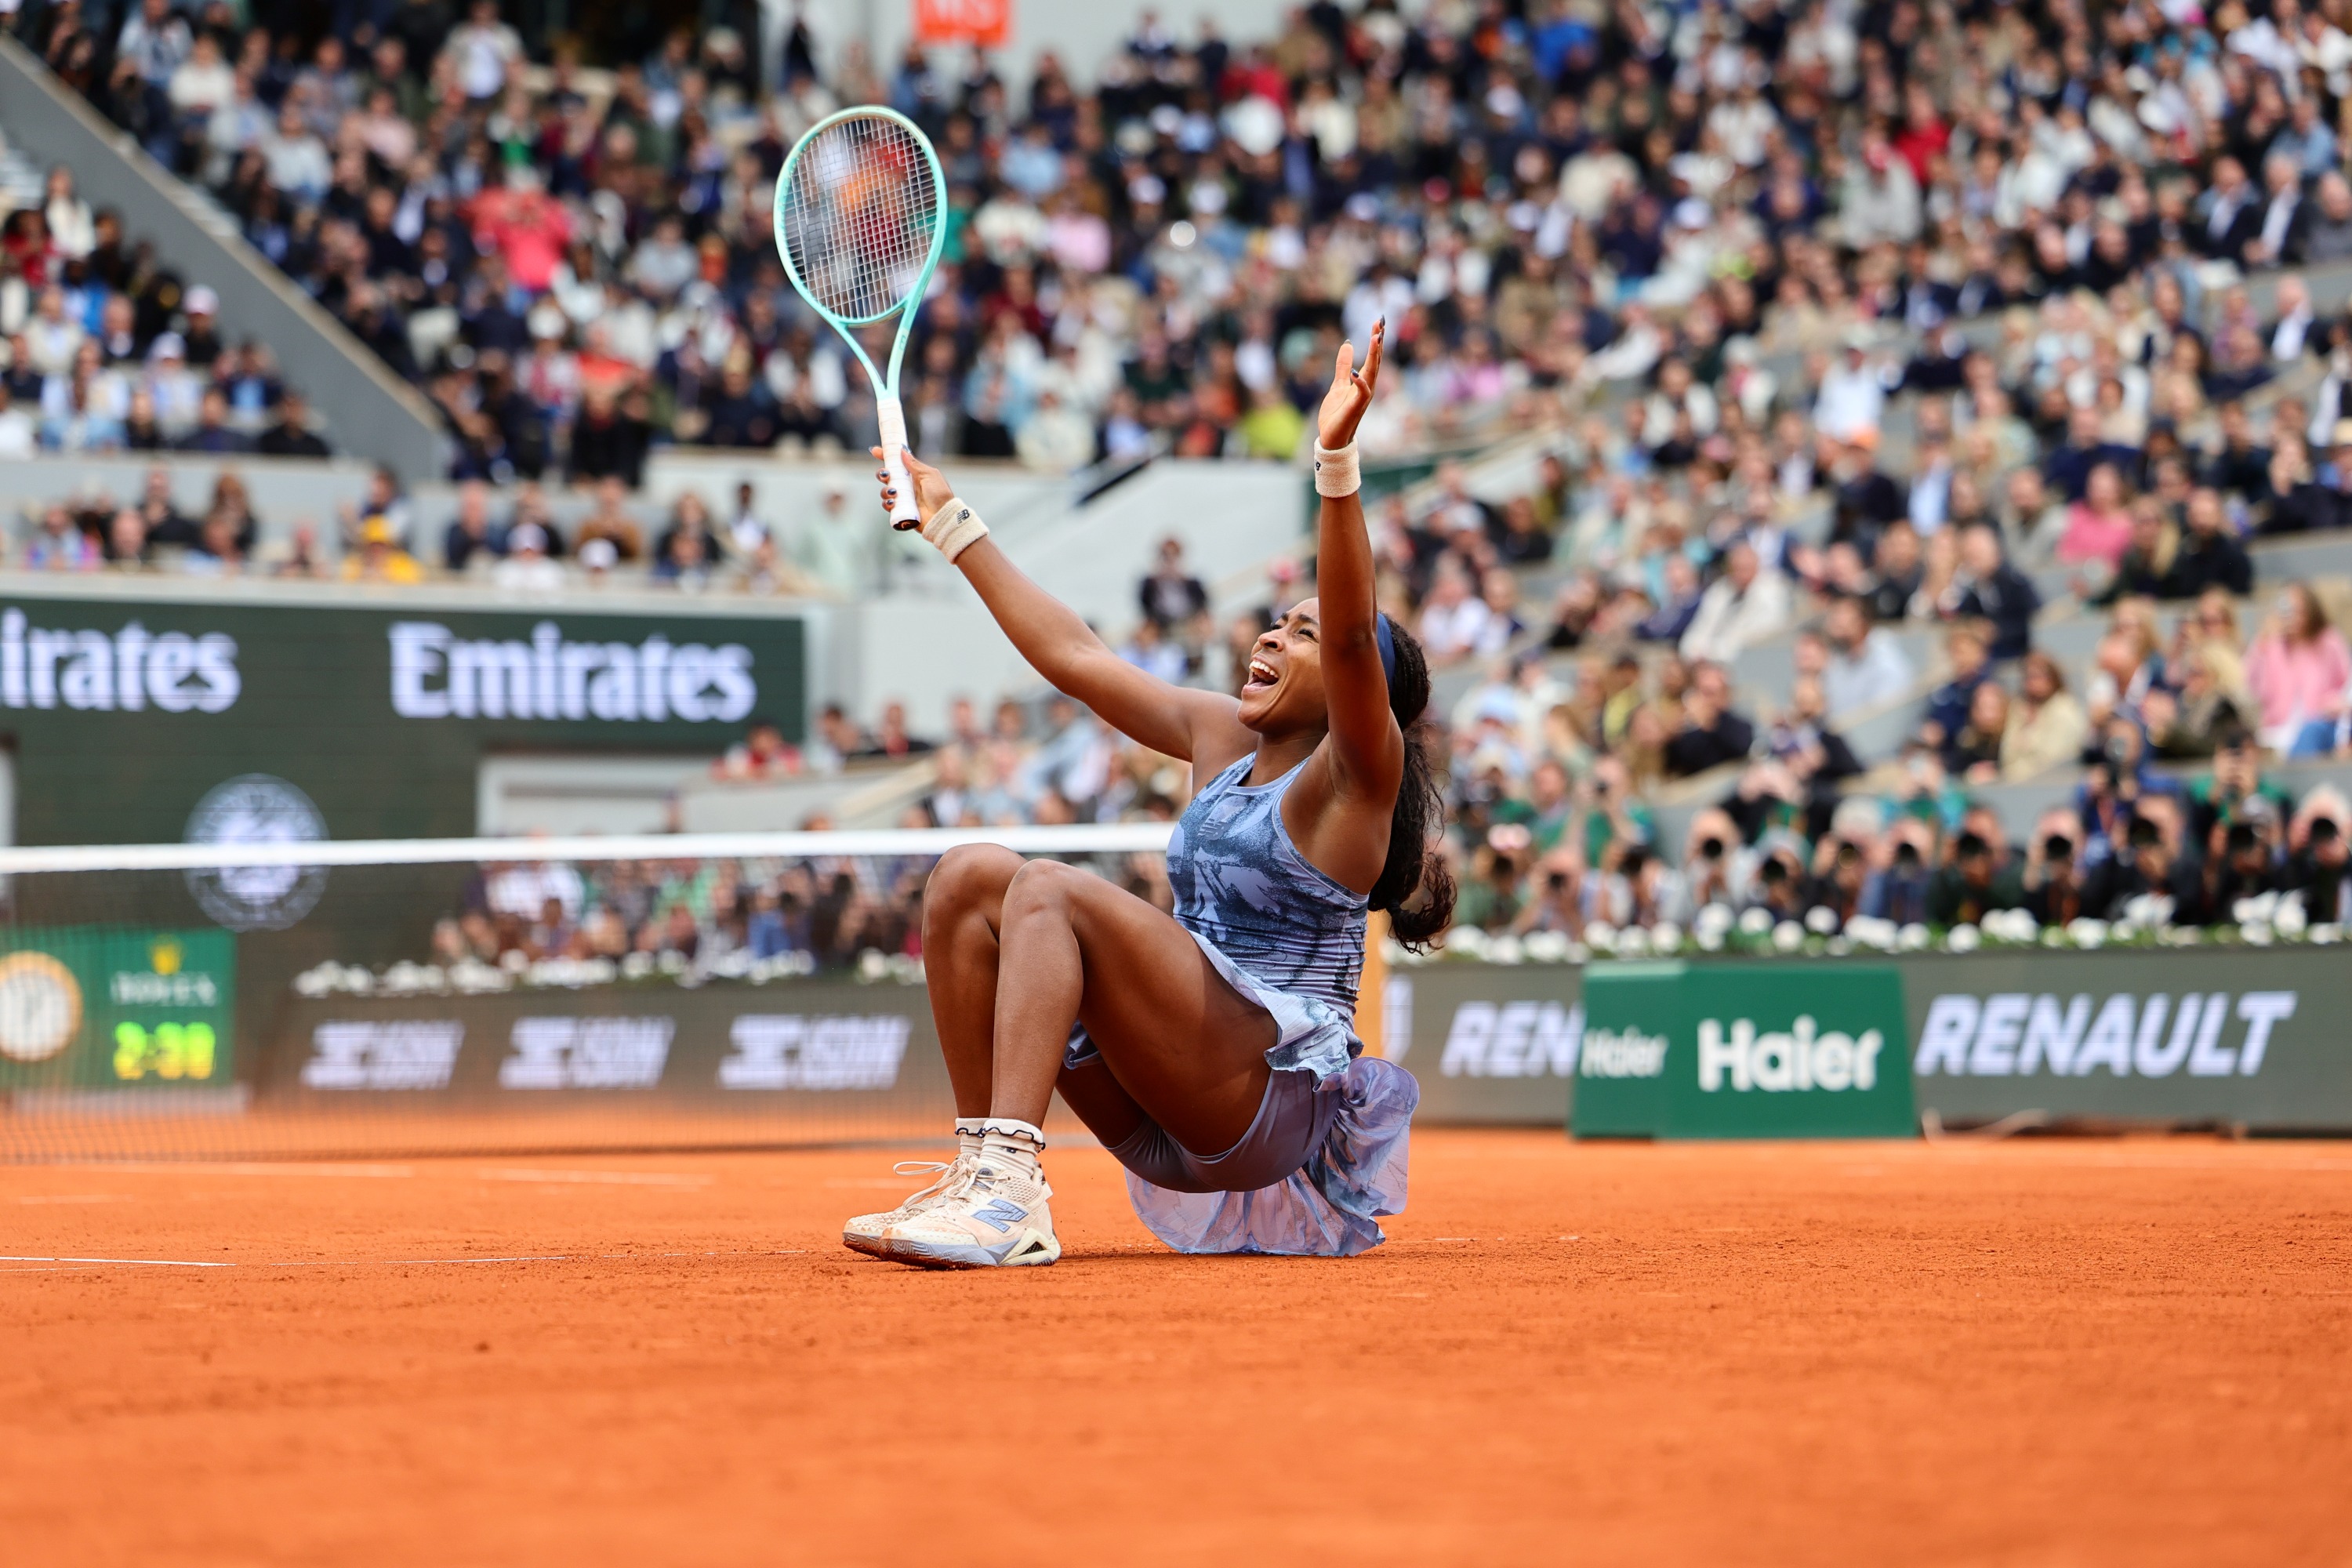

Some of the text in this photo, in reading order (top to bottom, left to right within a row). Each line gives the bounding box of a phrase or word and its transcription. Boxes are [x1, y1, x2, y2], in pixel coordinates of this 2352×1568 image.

[390, 621, 757, 722] Emirates
[1581, 1025, 1668, 1078] Haier
[1697, 1015, 1882, 1091] Haier
[1914, 991, 2297, 1076] RENAULT
